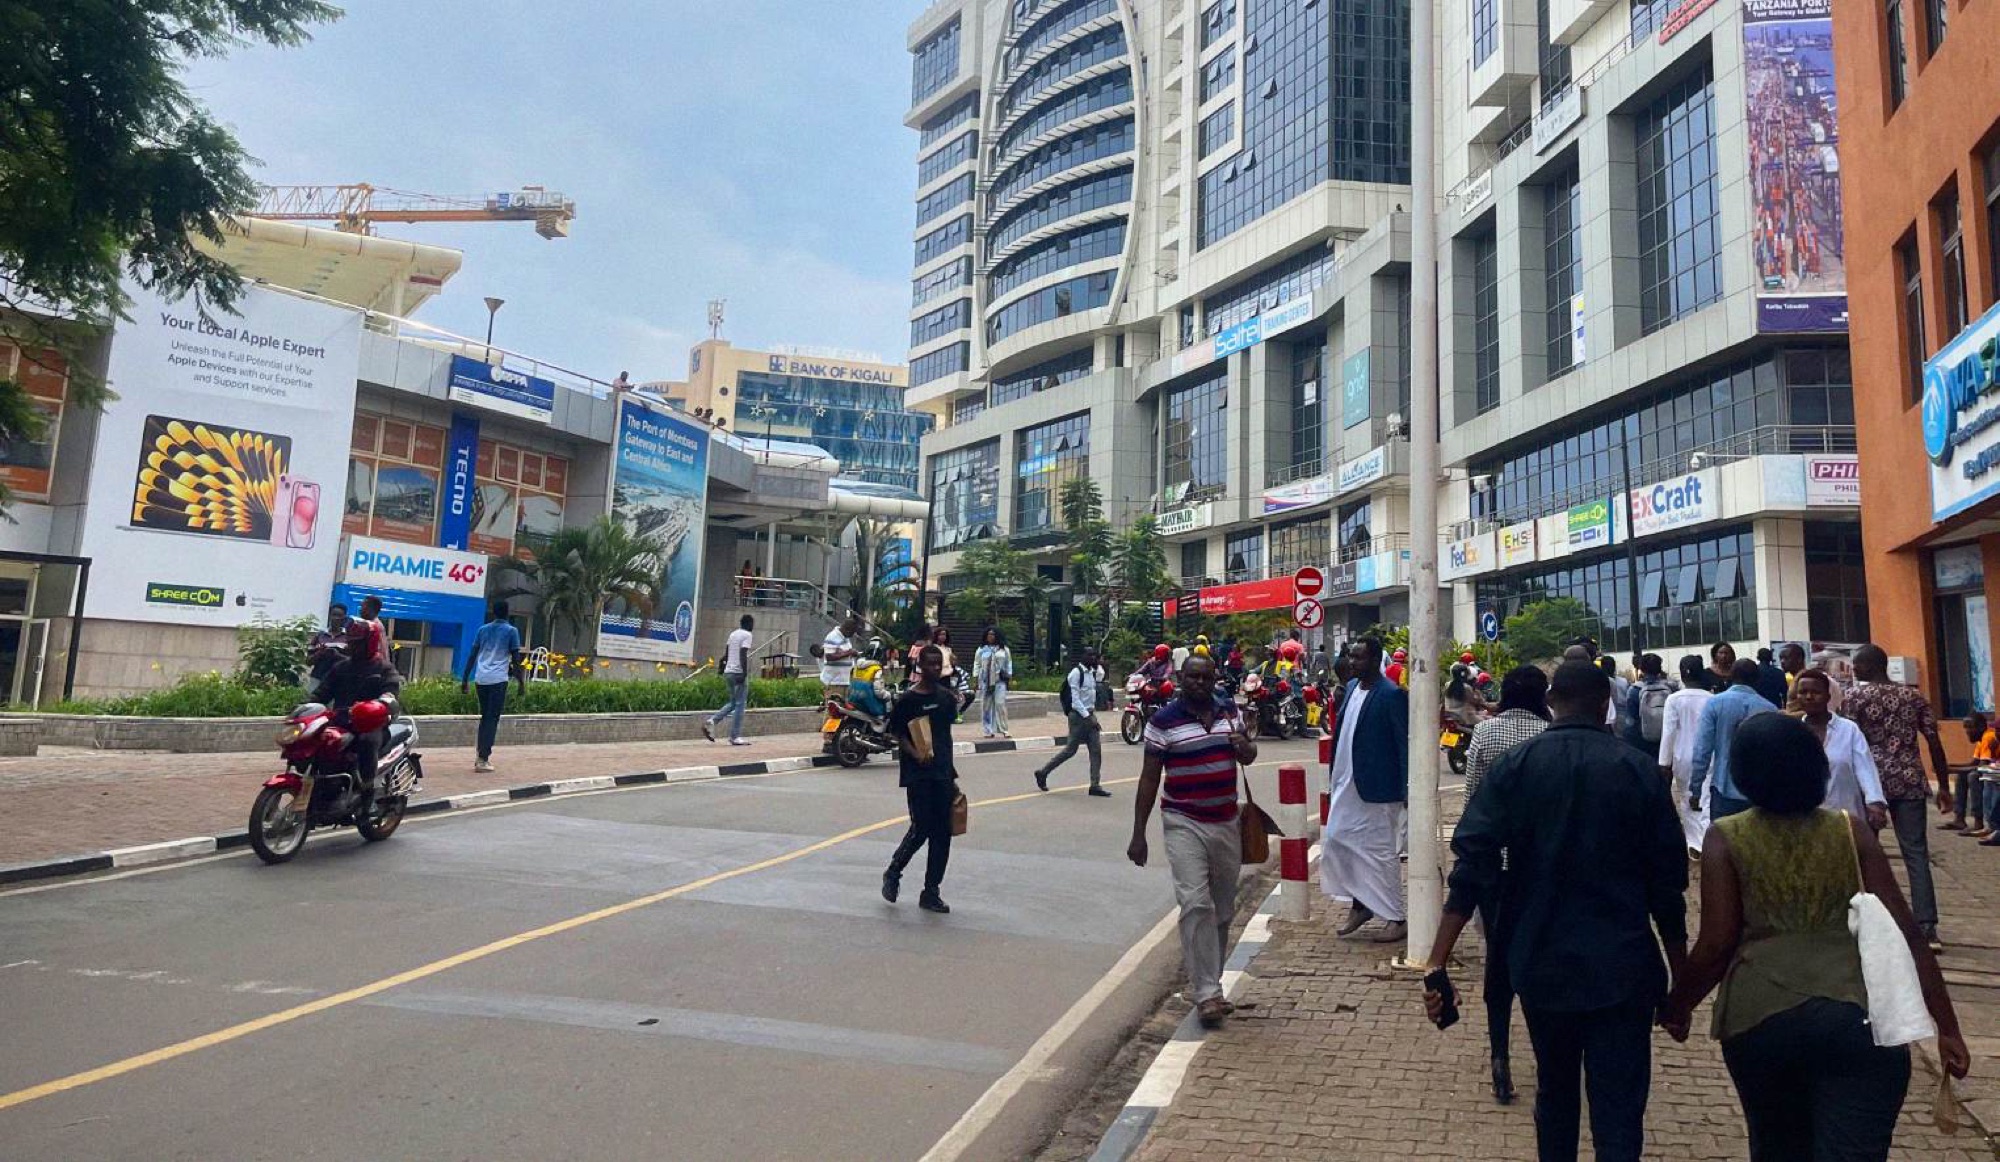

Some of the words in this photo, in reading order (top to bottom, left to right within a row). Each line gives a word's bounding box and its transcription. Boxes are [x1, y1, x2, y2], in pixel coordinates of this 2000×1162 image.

[1745, 0, 1798, 12] TANZANIA
[161, 312, 195, 331] Your
[198, 318, 237, 340] Local
[239, 330, 280, 350] Apple
[282, 339, 325, 359] Expert
[168, 353, 198, 367] Apple
[199, 358, 237, 375] Devices
[239, 367, 258, 379] with
[259, 373, 274, 382] our
[275, 374, 313, 389] Expertise
[171, 339, 210, 356] Unleash
[212, 348, 227, 360] the
[228, 350, 245, 363] Full
[246, 354, 283, 371] Potential
[284, 363, 294, 371] of
[295, 365, 313, 376] Your
[790, 361, 827, 377] BANK
[830, 365, 847, 378] OF
[849, 367, 893, 384] KIGALI
[194, 374, 212, 384] and
[213, 375, 250, 391] Support
[251, 383, 286, 397] services
[625, 431, 656, 452] Gateway
[658, 442, 665, 455] to
[666, 445, 681, 460] East
[681, 453, 694, 465] and
[626, 413, 641, 430] The
[642, 420, 659, 436] Port
[659, 427, 668, 439] of
[668, 429, 698, 450] Mombasa
[452, 446, 470, 515] TECNO
[1818, 464, 1859, 477] PHI
[1631, 475, 1702, 519] ExCraft
[1451, 542, 1478, 568] FedEx
[1504, 531, 1528, 549] EHS
[353, 550, 444, 579] PIRAMIE
[448, 562, 484, 583] 4G+
[151, 588, 189, 600] SHREE
[189, 589, 220, 604] COM
